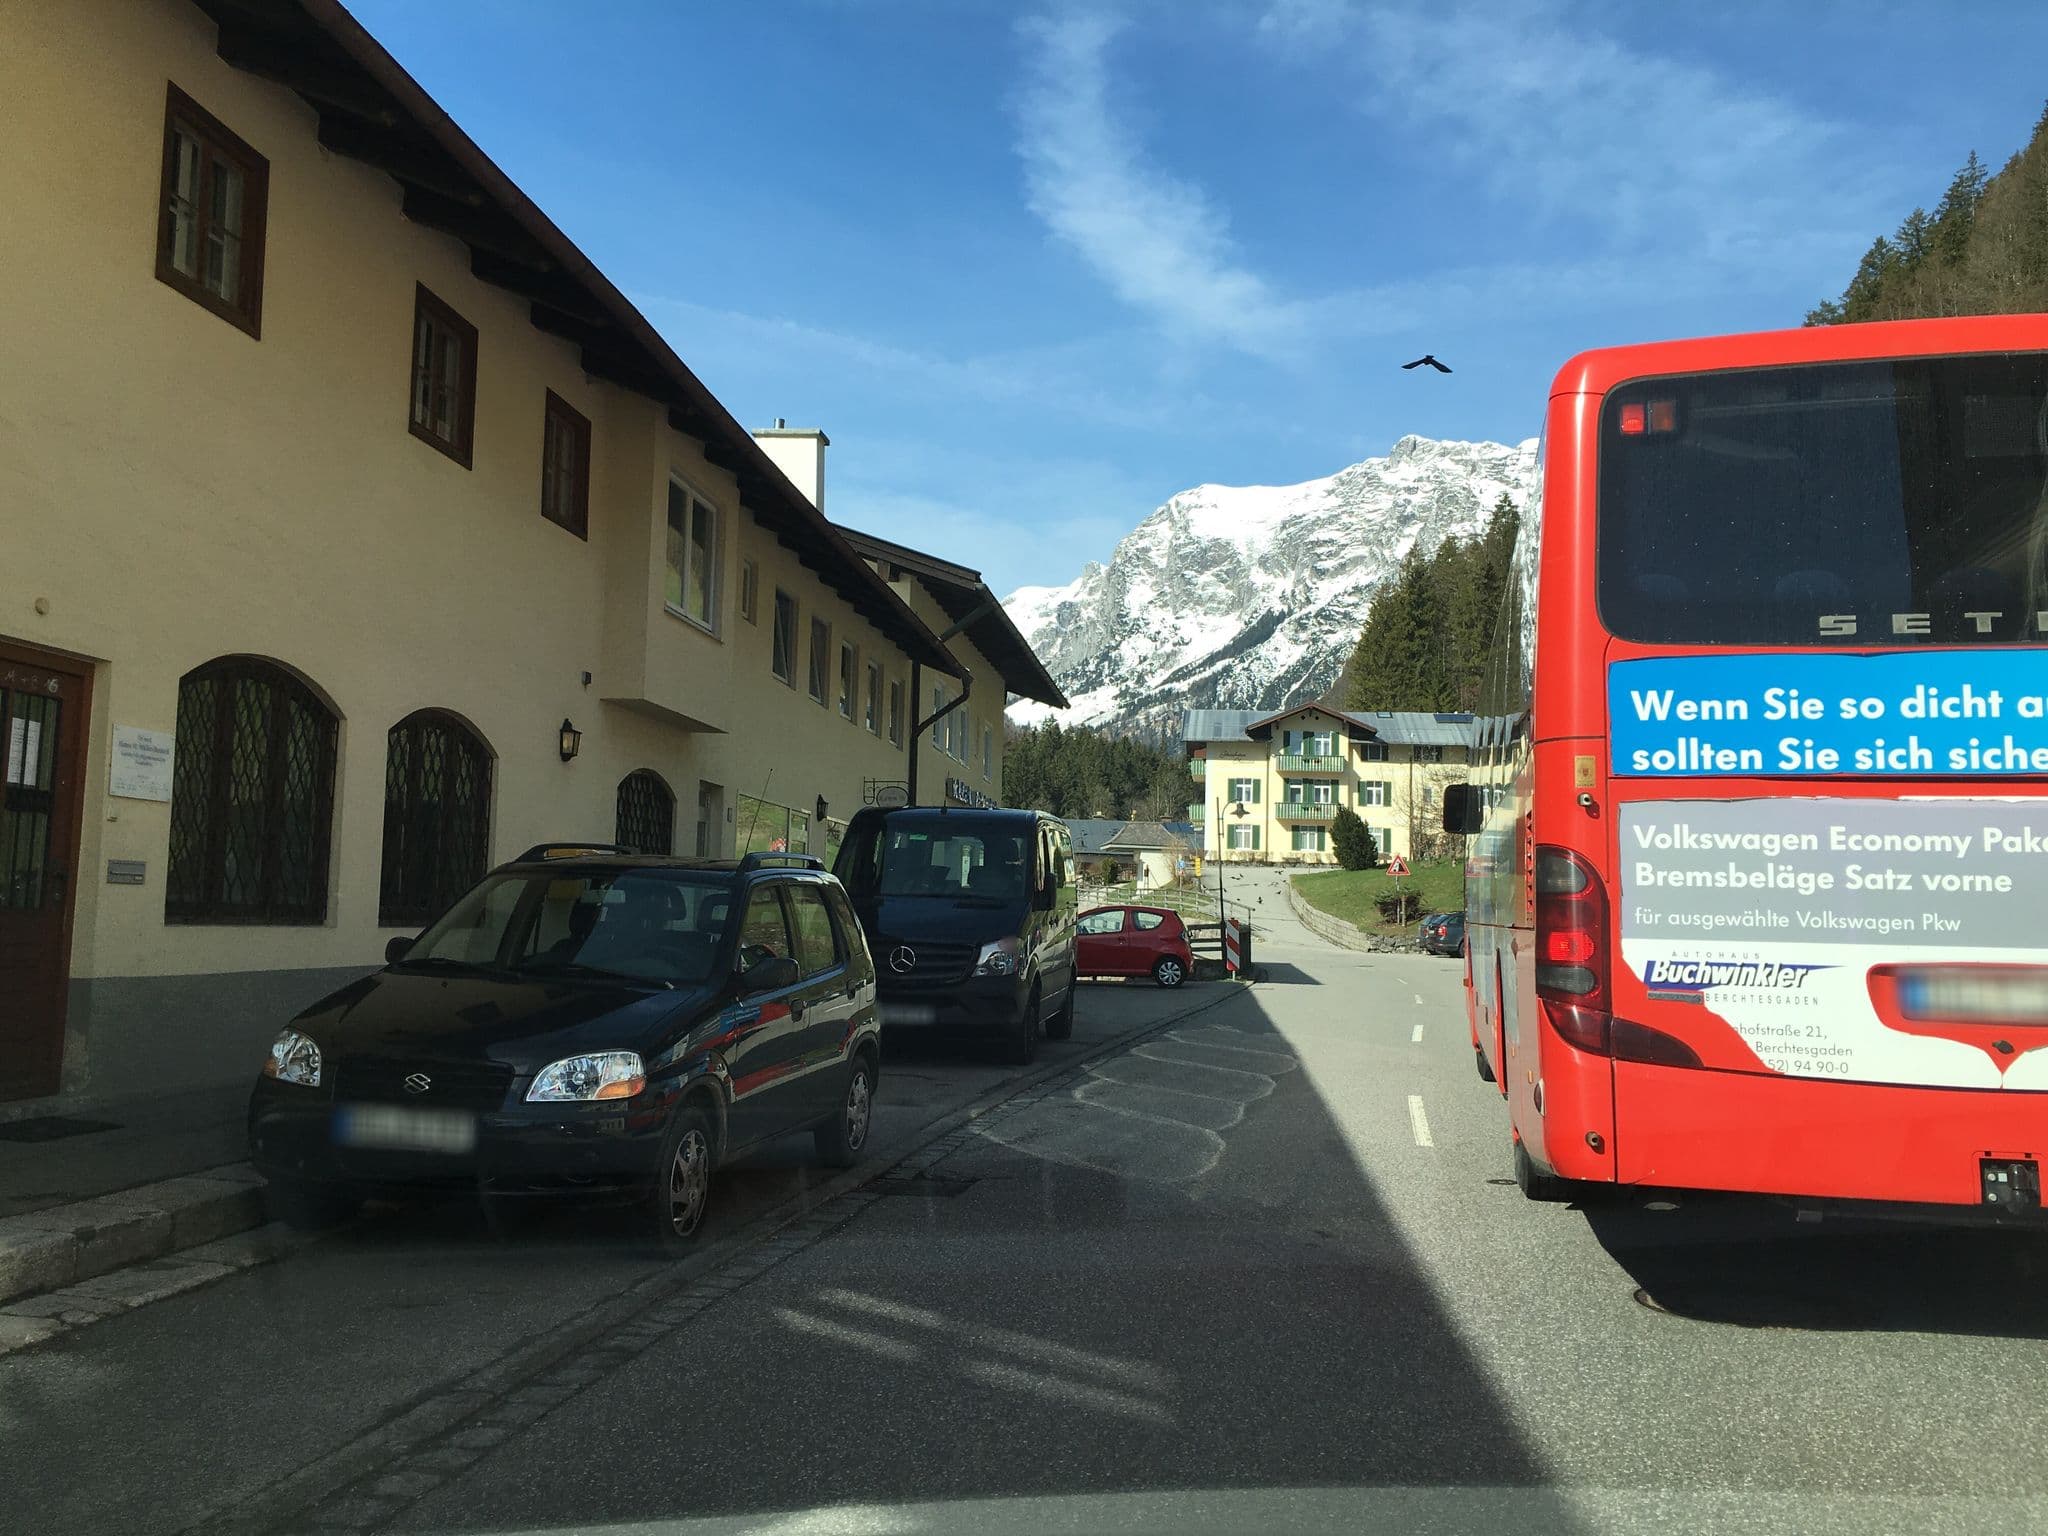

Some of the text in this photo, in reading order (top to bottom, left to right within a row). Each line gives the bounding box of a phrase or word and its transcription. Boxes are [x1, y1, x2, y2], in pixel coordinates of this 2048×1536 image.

[1630, 684, 2048, 721] Wenn Sie so dicht a
[1632, 737, 1763, 771] sollten
[1778, 737, 1840, 770] Sie
[1855, 736, 1934, 770] sich
[1633, 824, 1819, 856] Volkswagen
[1829, 825, 1973, 859] Economy
[1635, 861, 2013, 896] Bremsbeläge Satz vorne
[1634, 907, 1962, 934] für ausgewählte Volkswagen Pkw
[1671, 951, 1760, 960] AUTOHAUS
[1650, 960, 1809, 989] Buchwinkler
[1705, 992, 1819, 1006] BERCHTESGADEN
[1805, 1025, 1828, 1040] 21,
[1755, 1040, 1853, 1058] Berchtesgaden
[1794, 1060, 1811, 1072] 94
[1816, 1061, 1849, 1074] 90-0
